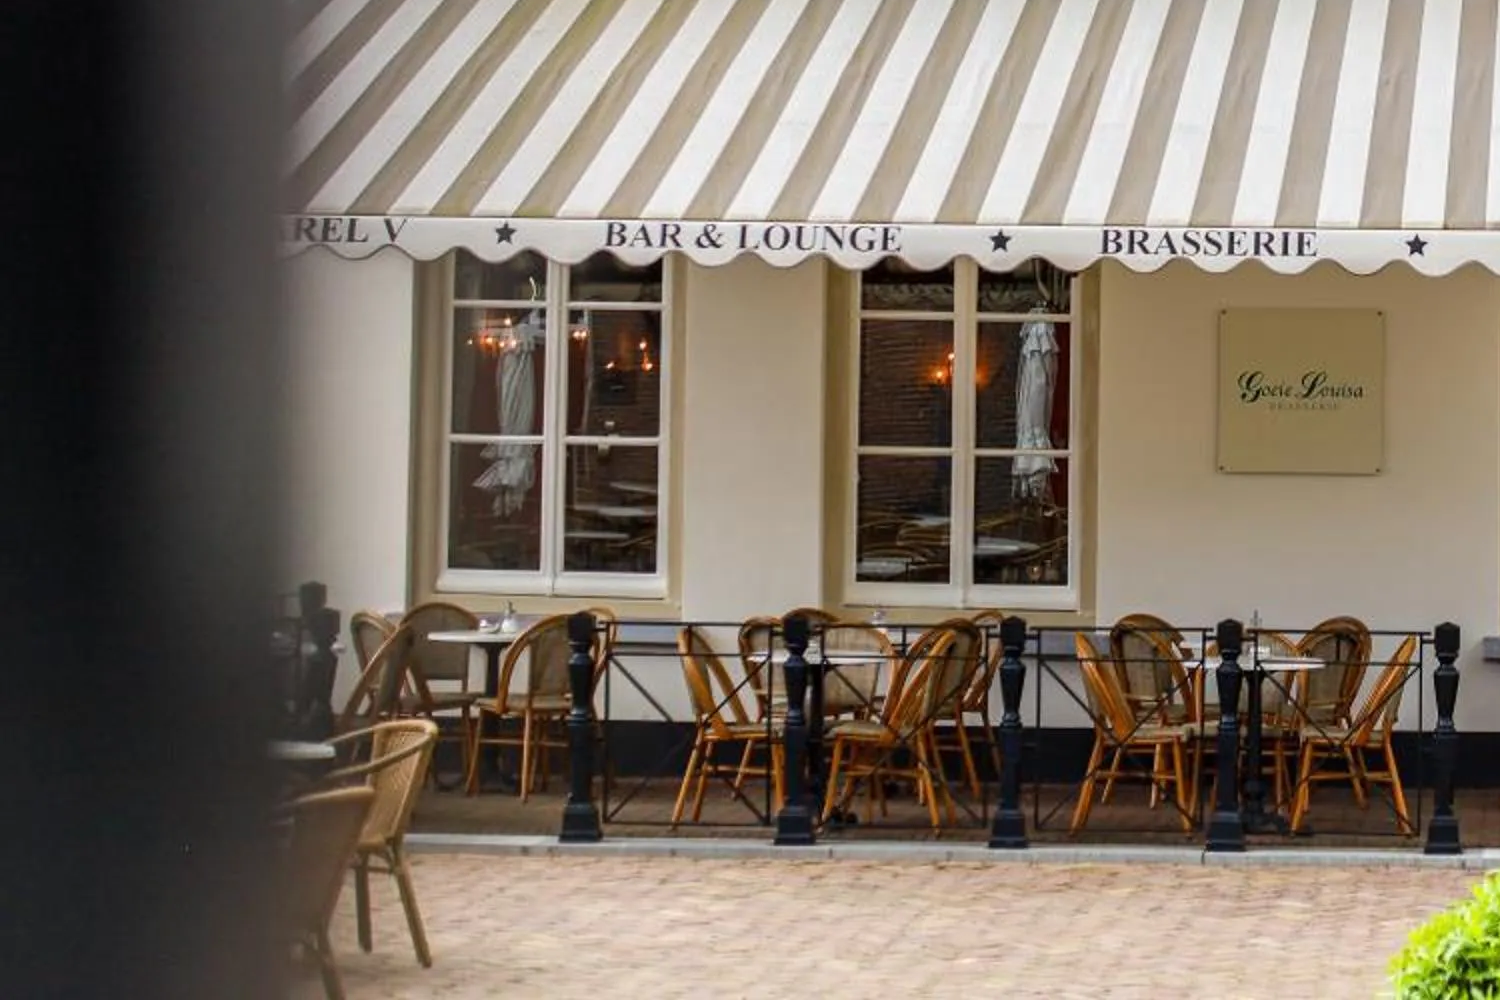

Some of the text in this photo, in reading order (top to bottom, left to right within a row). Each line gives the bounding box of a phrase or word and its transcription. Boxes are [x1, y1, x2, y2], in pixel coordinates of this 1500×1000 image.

[383, 217, 409, 243] V
[604, 222, 903, 252] BAR & LOUNGE
[1099, 228, 1319, 259] BRASSERIE
[1237, 370, 1364, 404] Goeie Louisa
